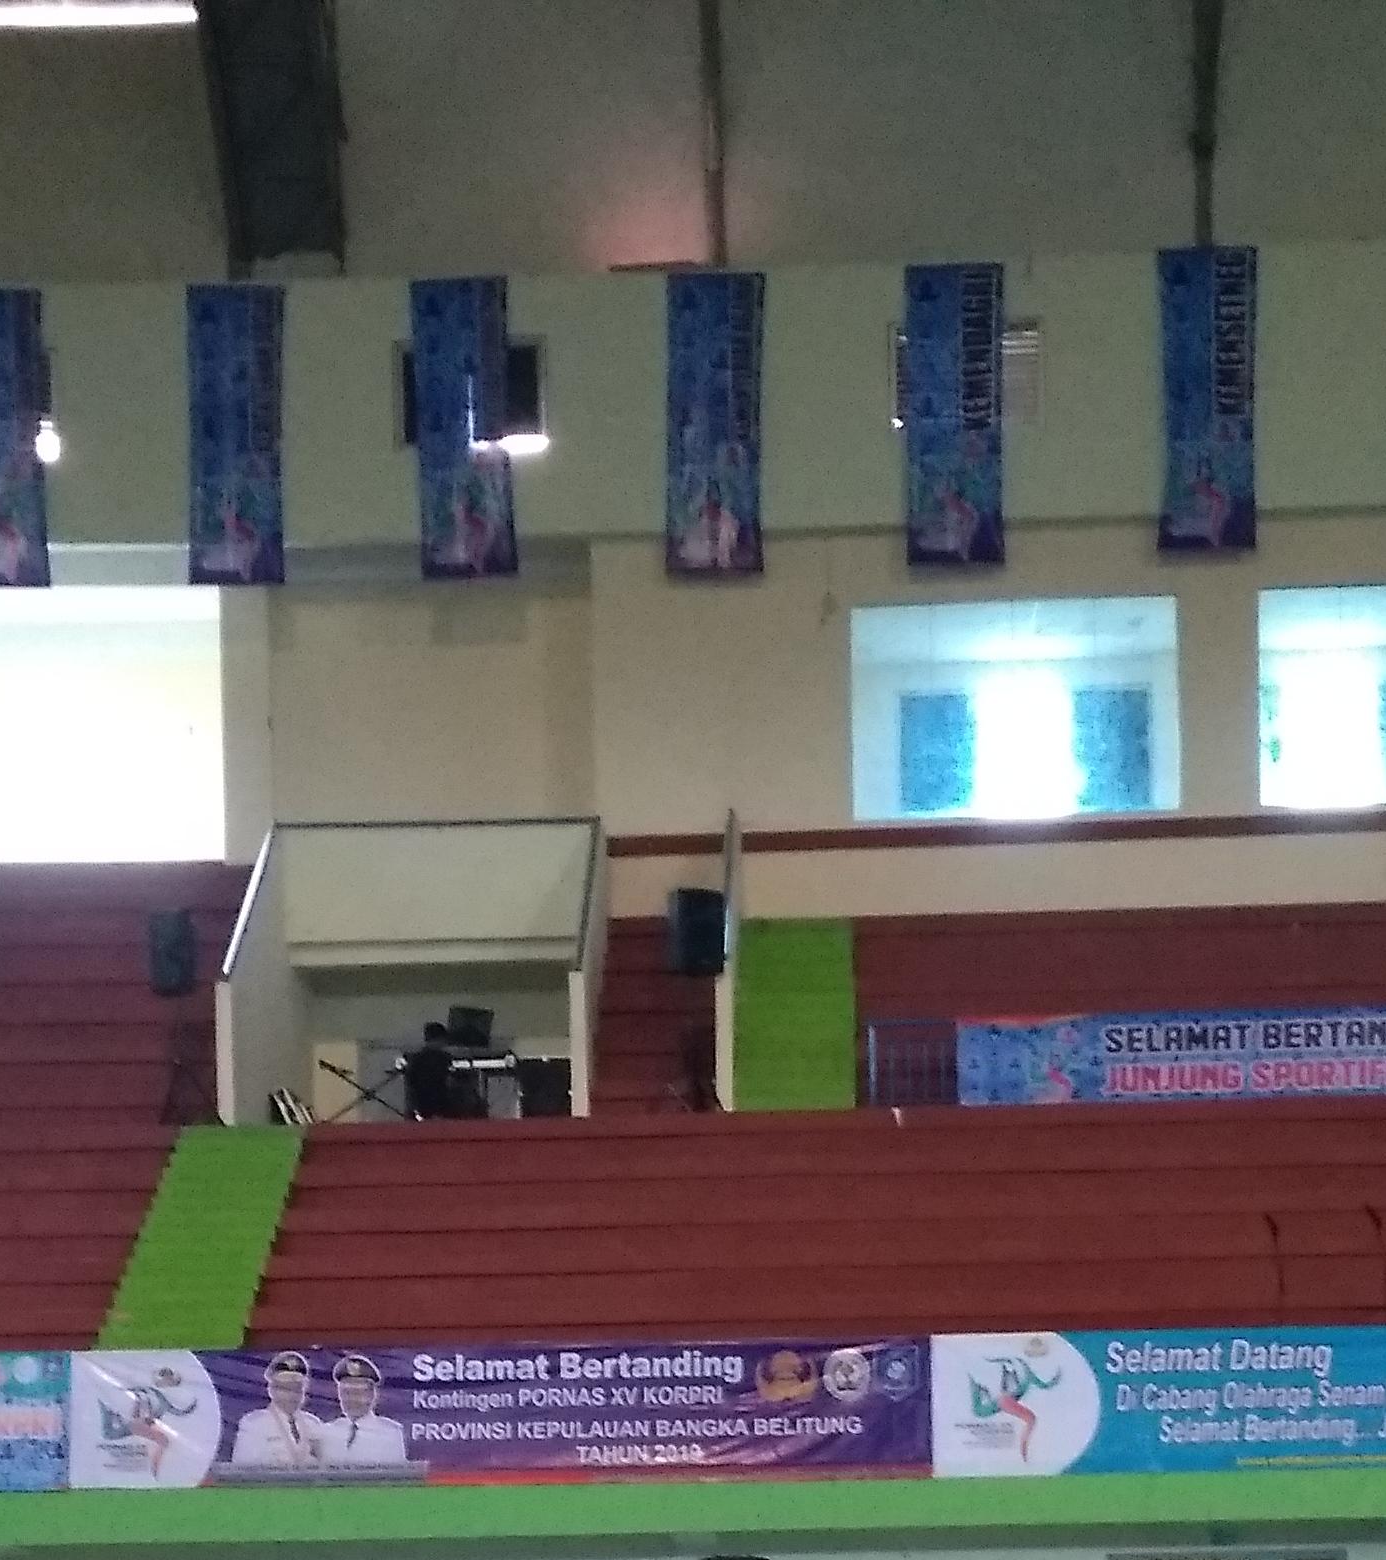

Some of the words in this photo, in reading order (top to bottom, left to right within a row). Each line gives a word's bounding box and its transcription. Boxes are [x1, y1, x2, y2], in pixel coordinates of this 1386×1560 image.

[1105, 1021, 1252, 1054] SELAMAT
[1104, 1061, 1242, 1095] JUNJUNG
[413, 1354, 550, 1383] Selamat
[560, 1351, 743, 1384] Bertanding
[1106, 1340, 1222, 1373] Selamat
[1230, 1339, 1333, 1377] Datang
[413, 1391, 512, 1412] Kontingen
[518, 1388, 606, 1407] PORNAS
[610, 1386, 637, 1406] XV
[643, 1385, 724, 1405] KORPRI
[1142, 1382, 1218, 1415] Cabang
[1223, 1381, 1312, 1414] Olahraga
[1318, 1379, 1384, 1406] Senam
[411, 1423, 512, 1441] PROVINSI
[518, 1420, 649, 1440] KEPULAUAN
[656, 1418, 749, 1438] BANGKA
[754, 1416, 863, 1437] BELITUNG
[1160, 1415, 1240, 1443] Selamat
[576, 1445, 648, 1464] TAHUN
